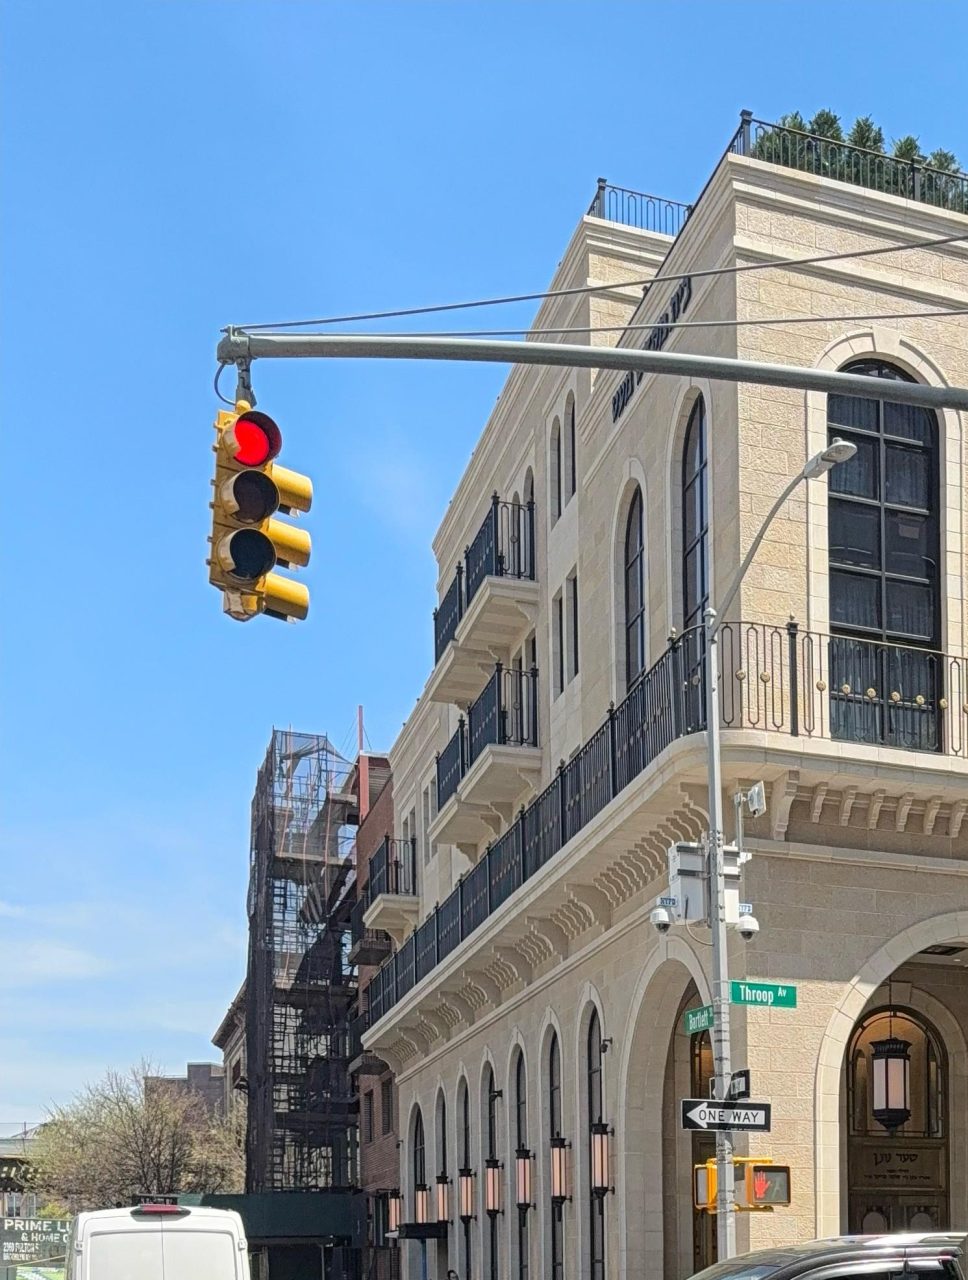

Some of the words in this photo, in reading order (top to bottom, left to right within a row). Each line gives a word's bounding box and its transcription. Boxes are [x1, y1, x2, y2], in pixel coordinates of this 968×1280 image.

[739, 985, 774, 1005] Throop
[777, 986, 787, 997] Av
[688, 1009, 709, 1030] Bartlett
[699, 1109, 725, 1122] ONE
[732, 1111, 759, 1123] WAY
[4, 1219, 52, 1231] PRIME
[21, 1232, 29, 1241] &
[31, 1232, 60, 1243] HOME
